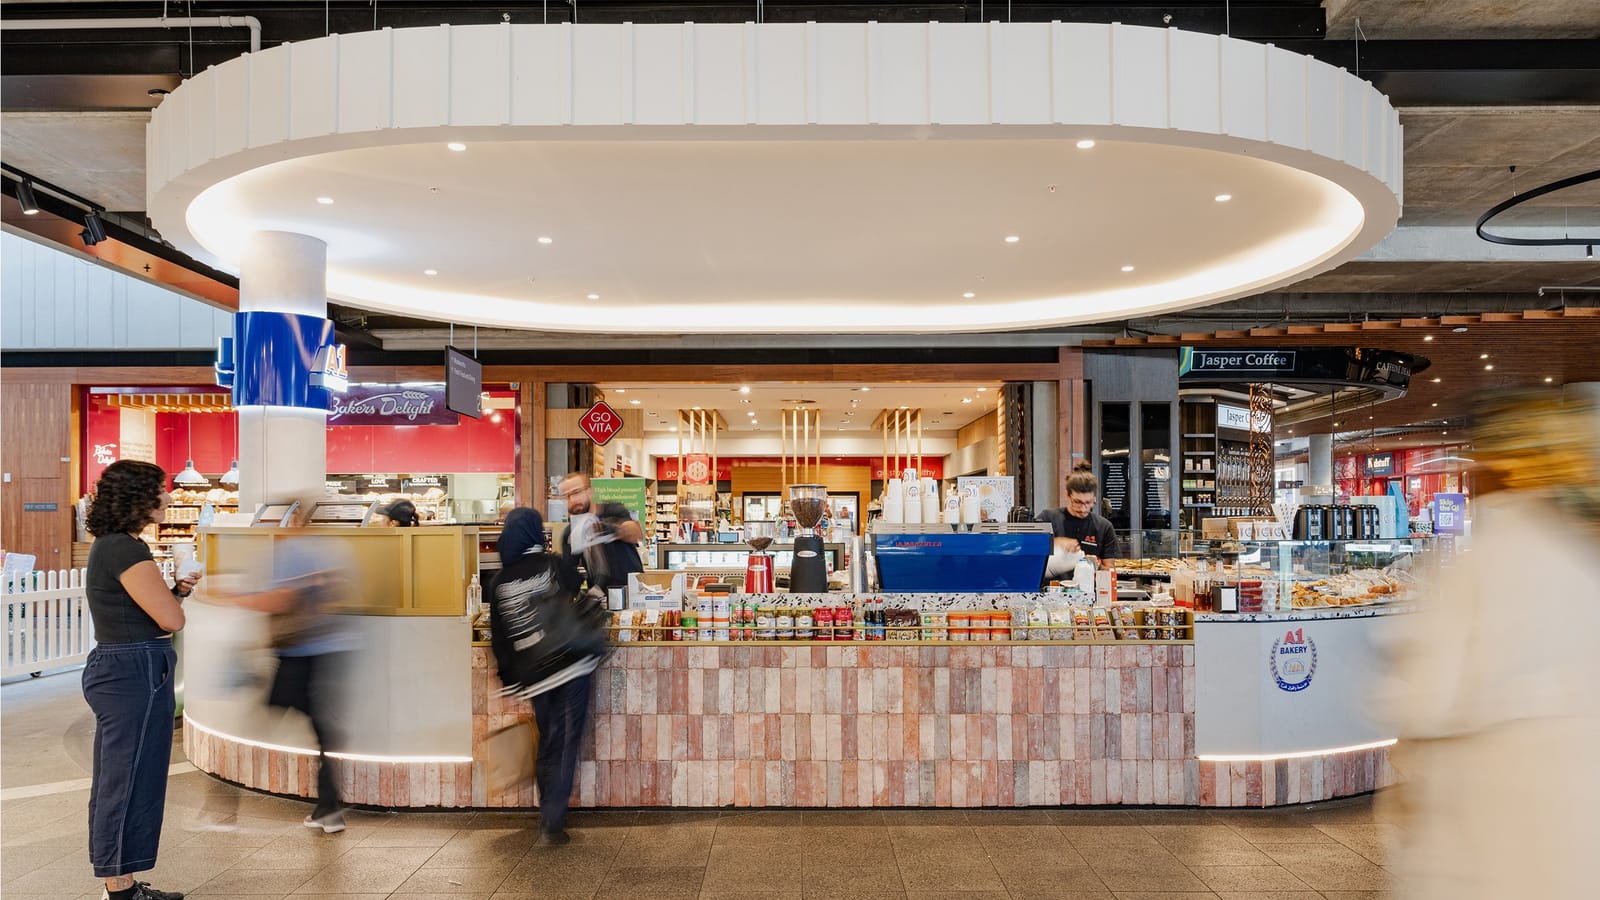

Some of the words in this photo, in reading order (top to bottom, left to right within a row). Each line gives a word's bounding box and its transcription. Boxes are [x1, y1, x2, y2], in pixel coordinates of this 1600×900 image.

[1199, 353, 1242, 368] Jasper
[1245, 353, 1287, 366] Coffee
[329, 397, 376, 421] Bakers
[380, 396, 435, 421] Delight
[590, 412, 611, 422] GO
[1226, 408, 1244, 425] Jasper
[588, 423, 613, 433] VITA
[1284, 627, 1305, 644] A1
[1280, 646, 1307, 655] BAKERY
